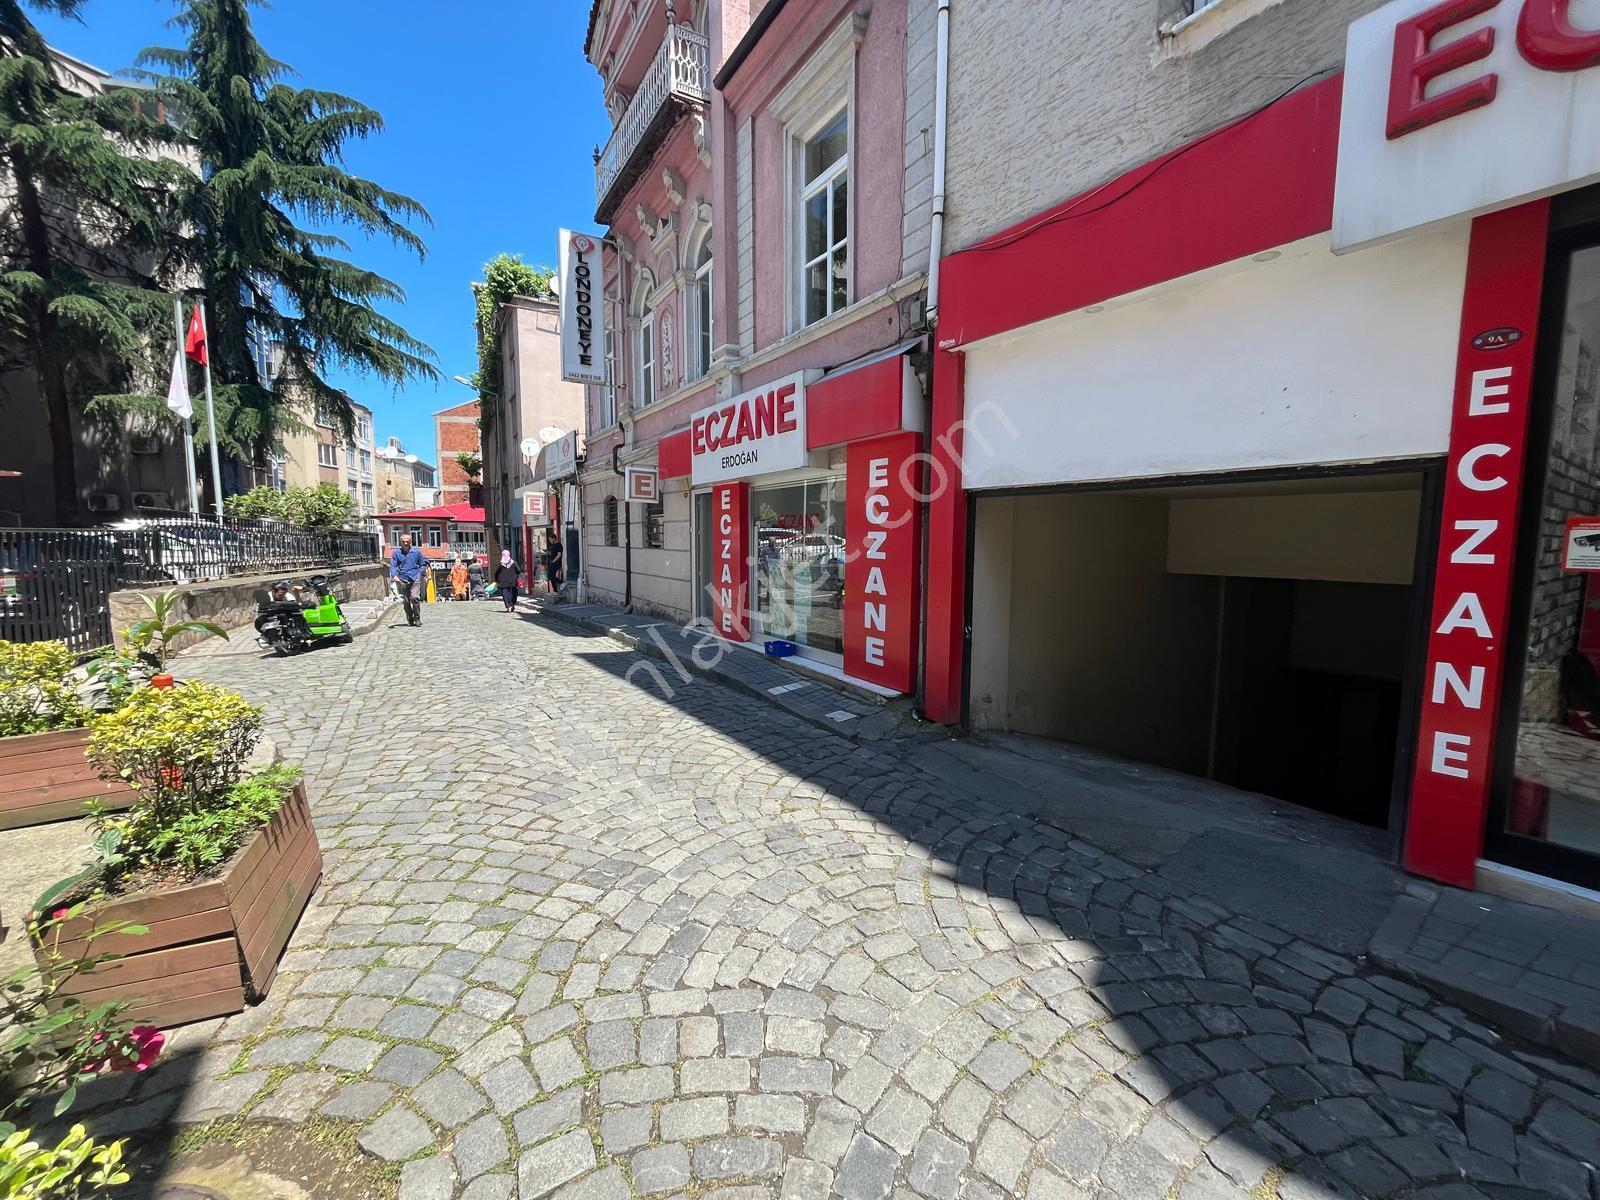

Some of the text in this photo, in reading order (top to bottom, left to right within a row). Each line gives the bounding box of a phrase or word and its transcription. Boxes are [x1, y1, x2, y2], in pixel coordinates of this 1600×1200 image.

[575, 251, 592, 366] LONDONEYE
[1488, 335, 1504, 344] 9A
[693, 383, 797, 455] ECZANE
[635, 475, 652, 497] E
[721, 449, 758, 468] ERDOĞAN
[530, 498, 542, 513] E
[720, 489, 732, 633] ECZANE
[864, 457, 889, 667] ECZANE
[1431, 366, 1513, 780] ECZANE
